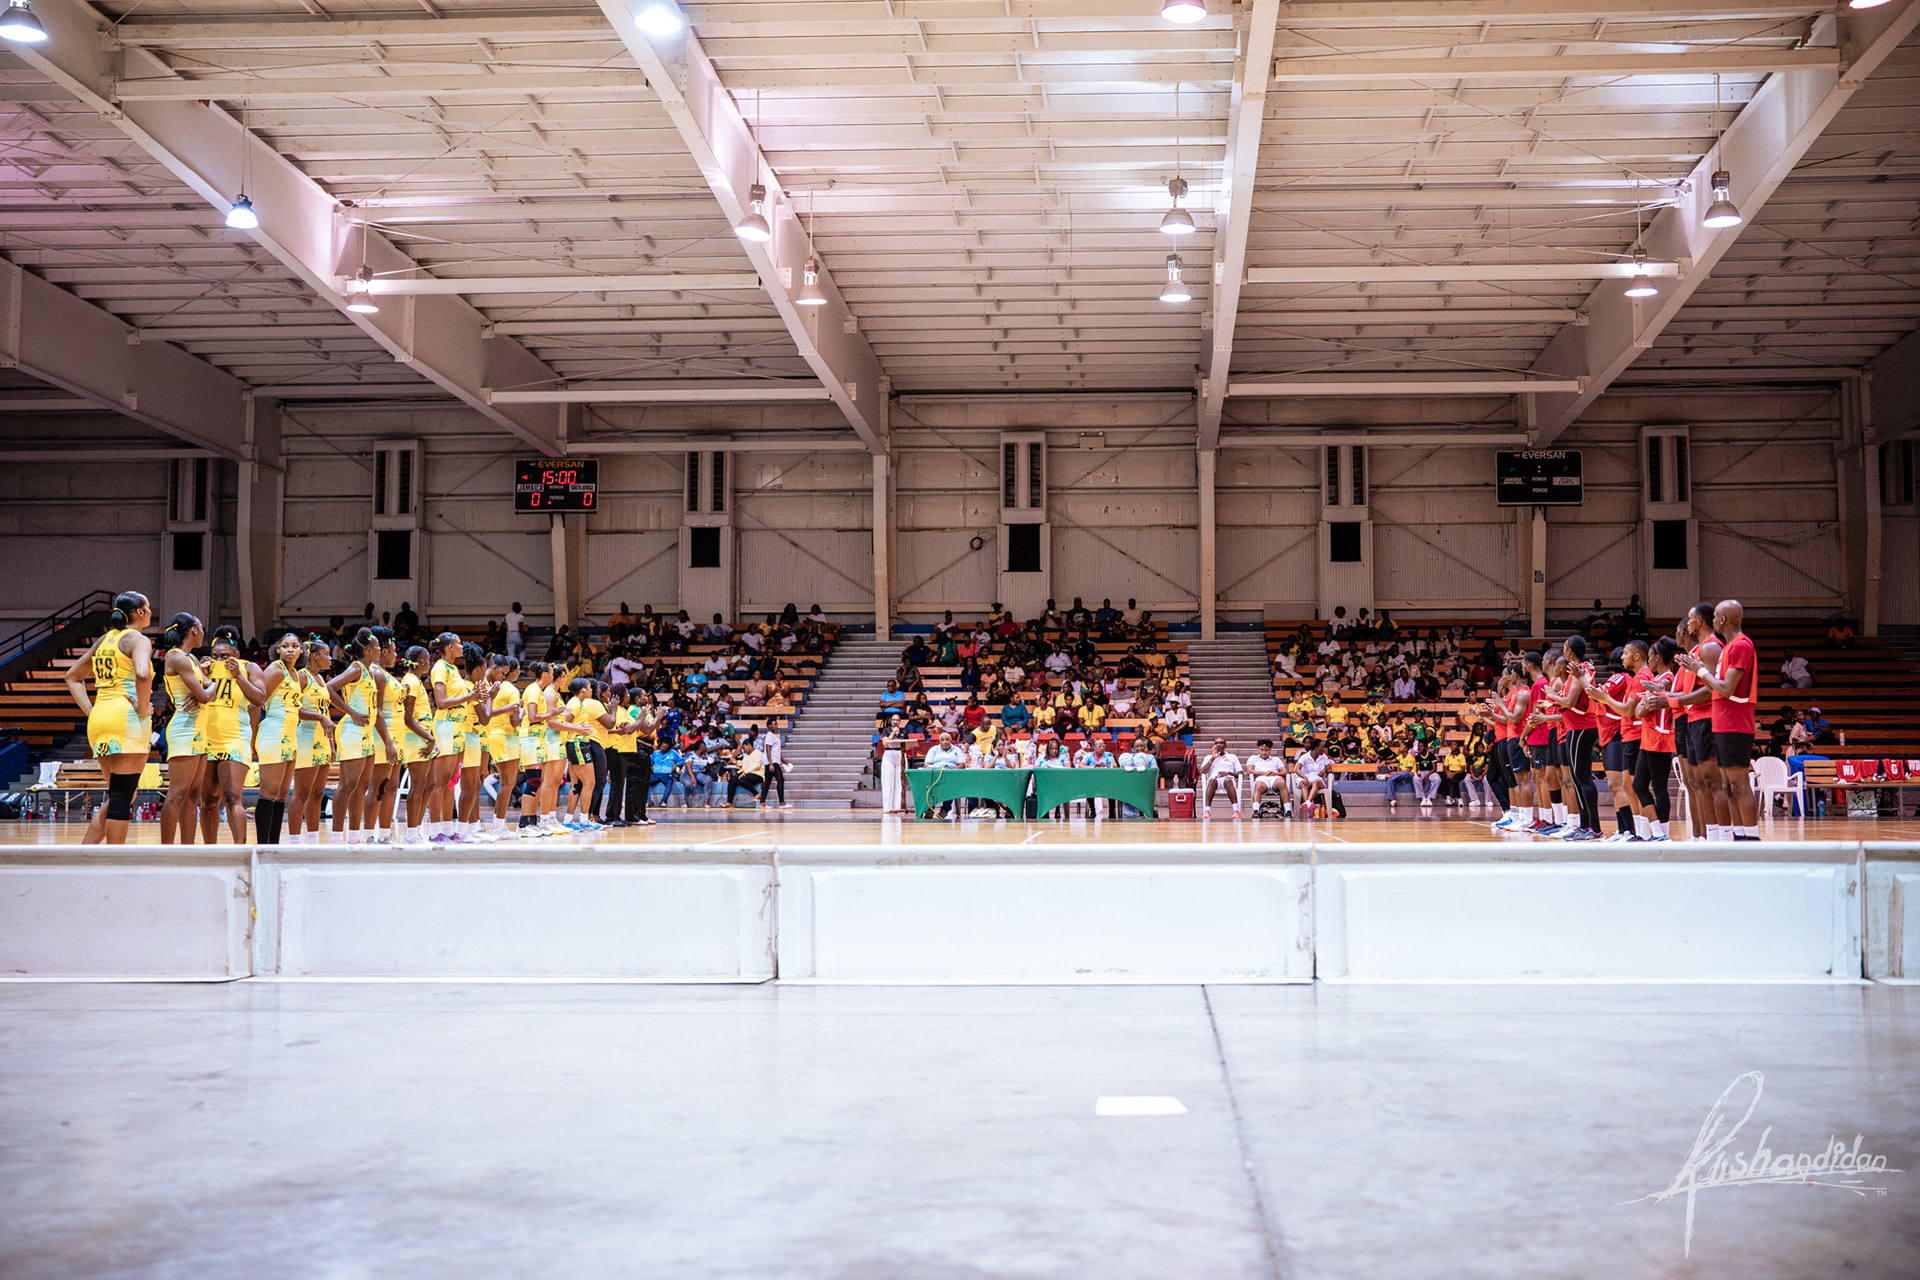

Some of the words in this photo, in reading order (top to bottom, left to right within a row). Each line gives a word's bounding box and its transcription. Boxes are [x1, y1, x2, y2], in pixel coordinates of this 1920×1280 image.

[542, 470, 577, 484] 15:00
[530, 492, 541, 506] 0
[583, 492, 593, 506] 0
[1842, 765, 1855, 776] WA
